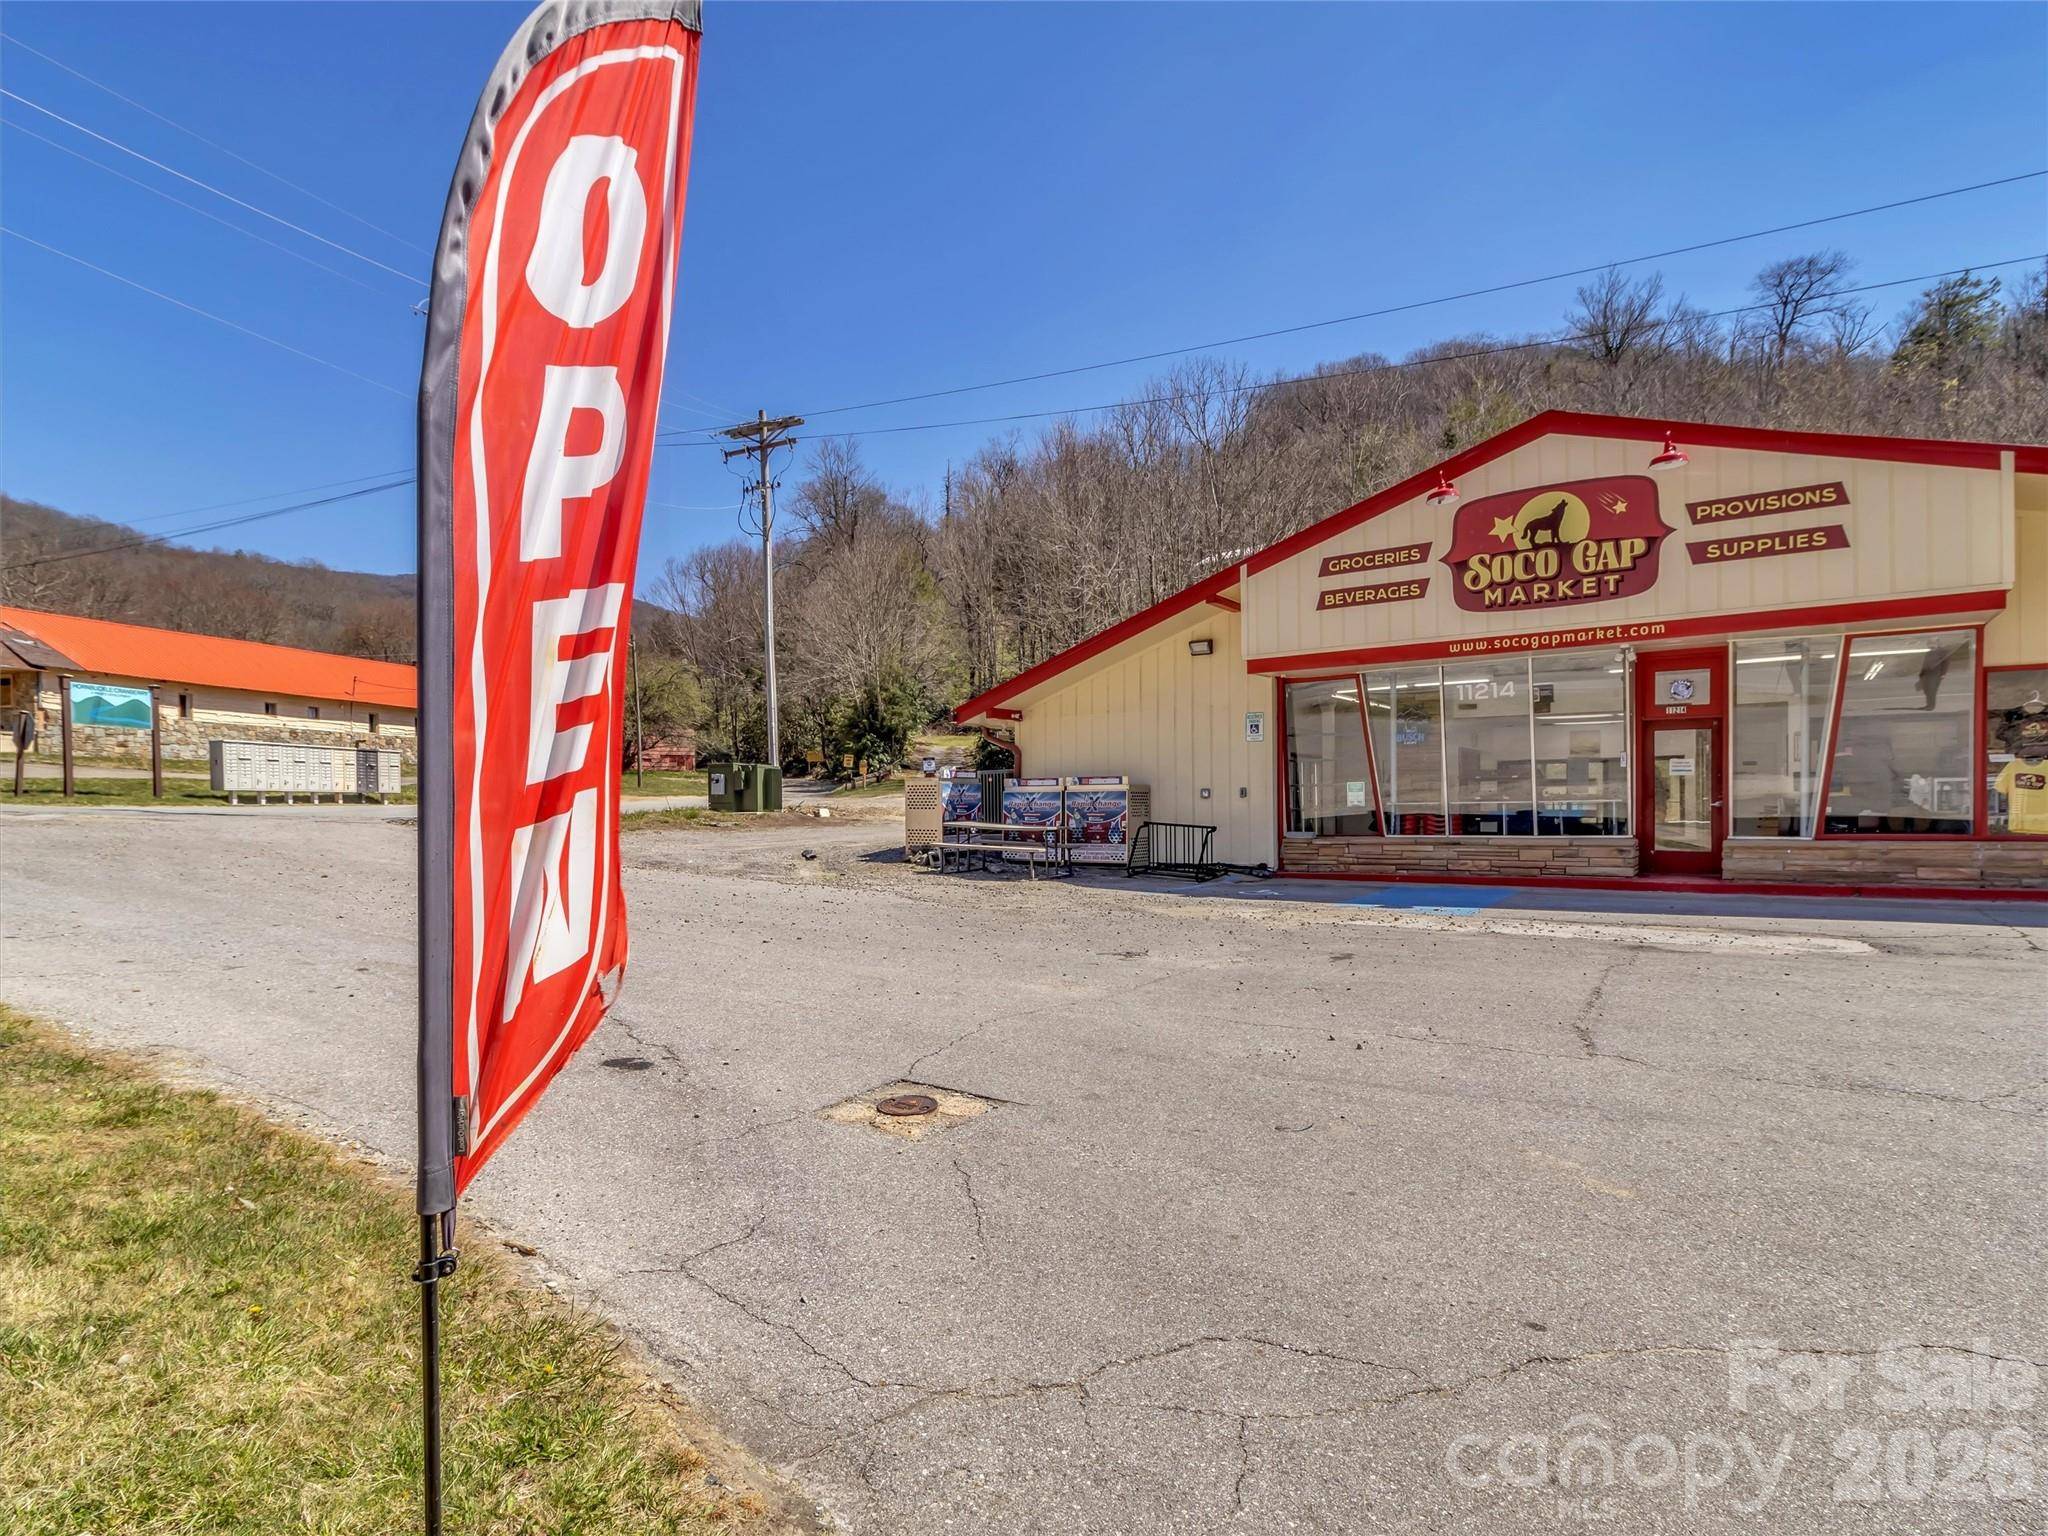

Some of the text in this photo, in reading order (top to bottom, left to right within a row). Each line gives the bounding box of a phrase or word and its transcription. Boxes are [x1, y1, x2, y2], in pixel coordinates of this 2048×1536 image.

[1695, 487, 1838, 520] PROVISIONS
[1328, 548, 1422, 572] GROCERIES
[1706, 531, 1828, 559] SUPPLIES
[502, 133, 648, 1024] OPEN
[1463, 537, 1649, 593] SOCO GAP
[1324, 583, 1421, 606] BEVERAGES
[1484, 574, 1623, 608] MARKET
[1449, 623, 1666, 653] www.socogapmarket.com
[1456, 680, 1517, 701] 11214
